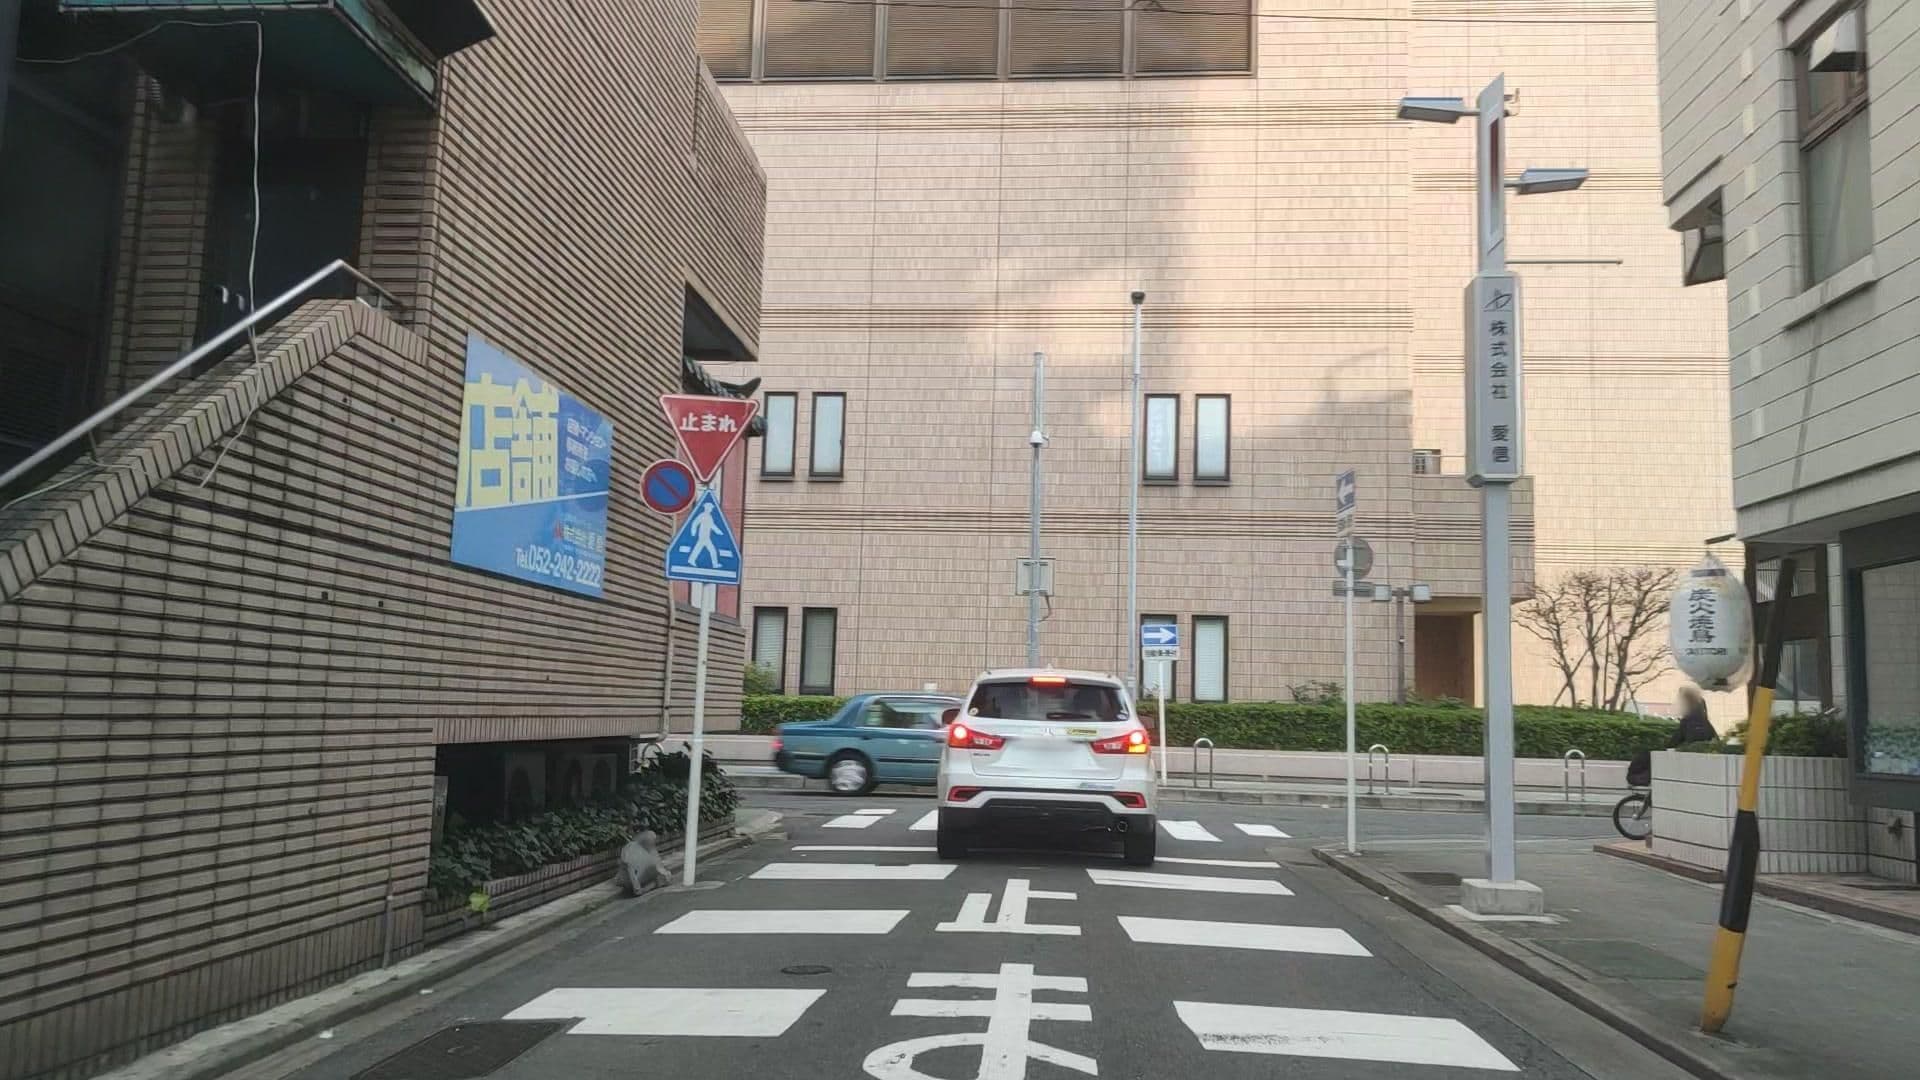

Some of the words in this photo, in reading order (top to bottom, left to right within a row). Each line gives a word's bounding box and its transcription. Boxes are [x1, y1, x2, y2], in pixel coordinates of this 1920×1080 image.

[1488, 320, 1509, 400] 株式会社
[679, 412, 738, 433] 止まれ
